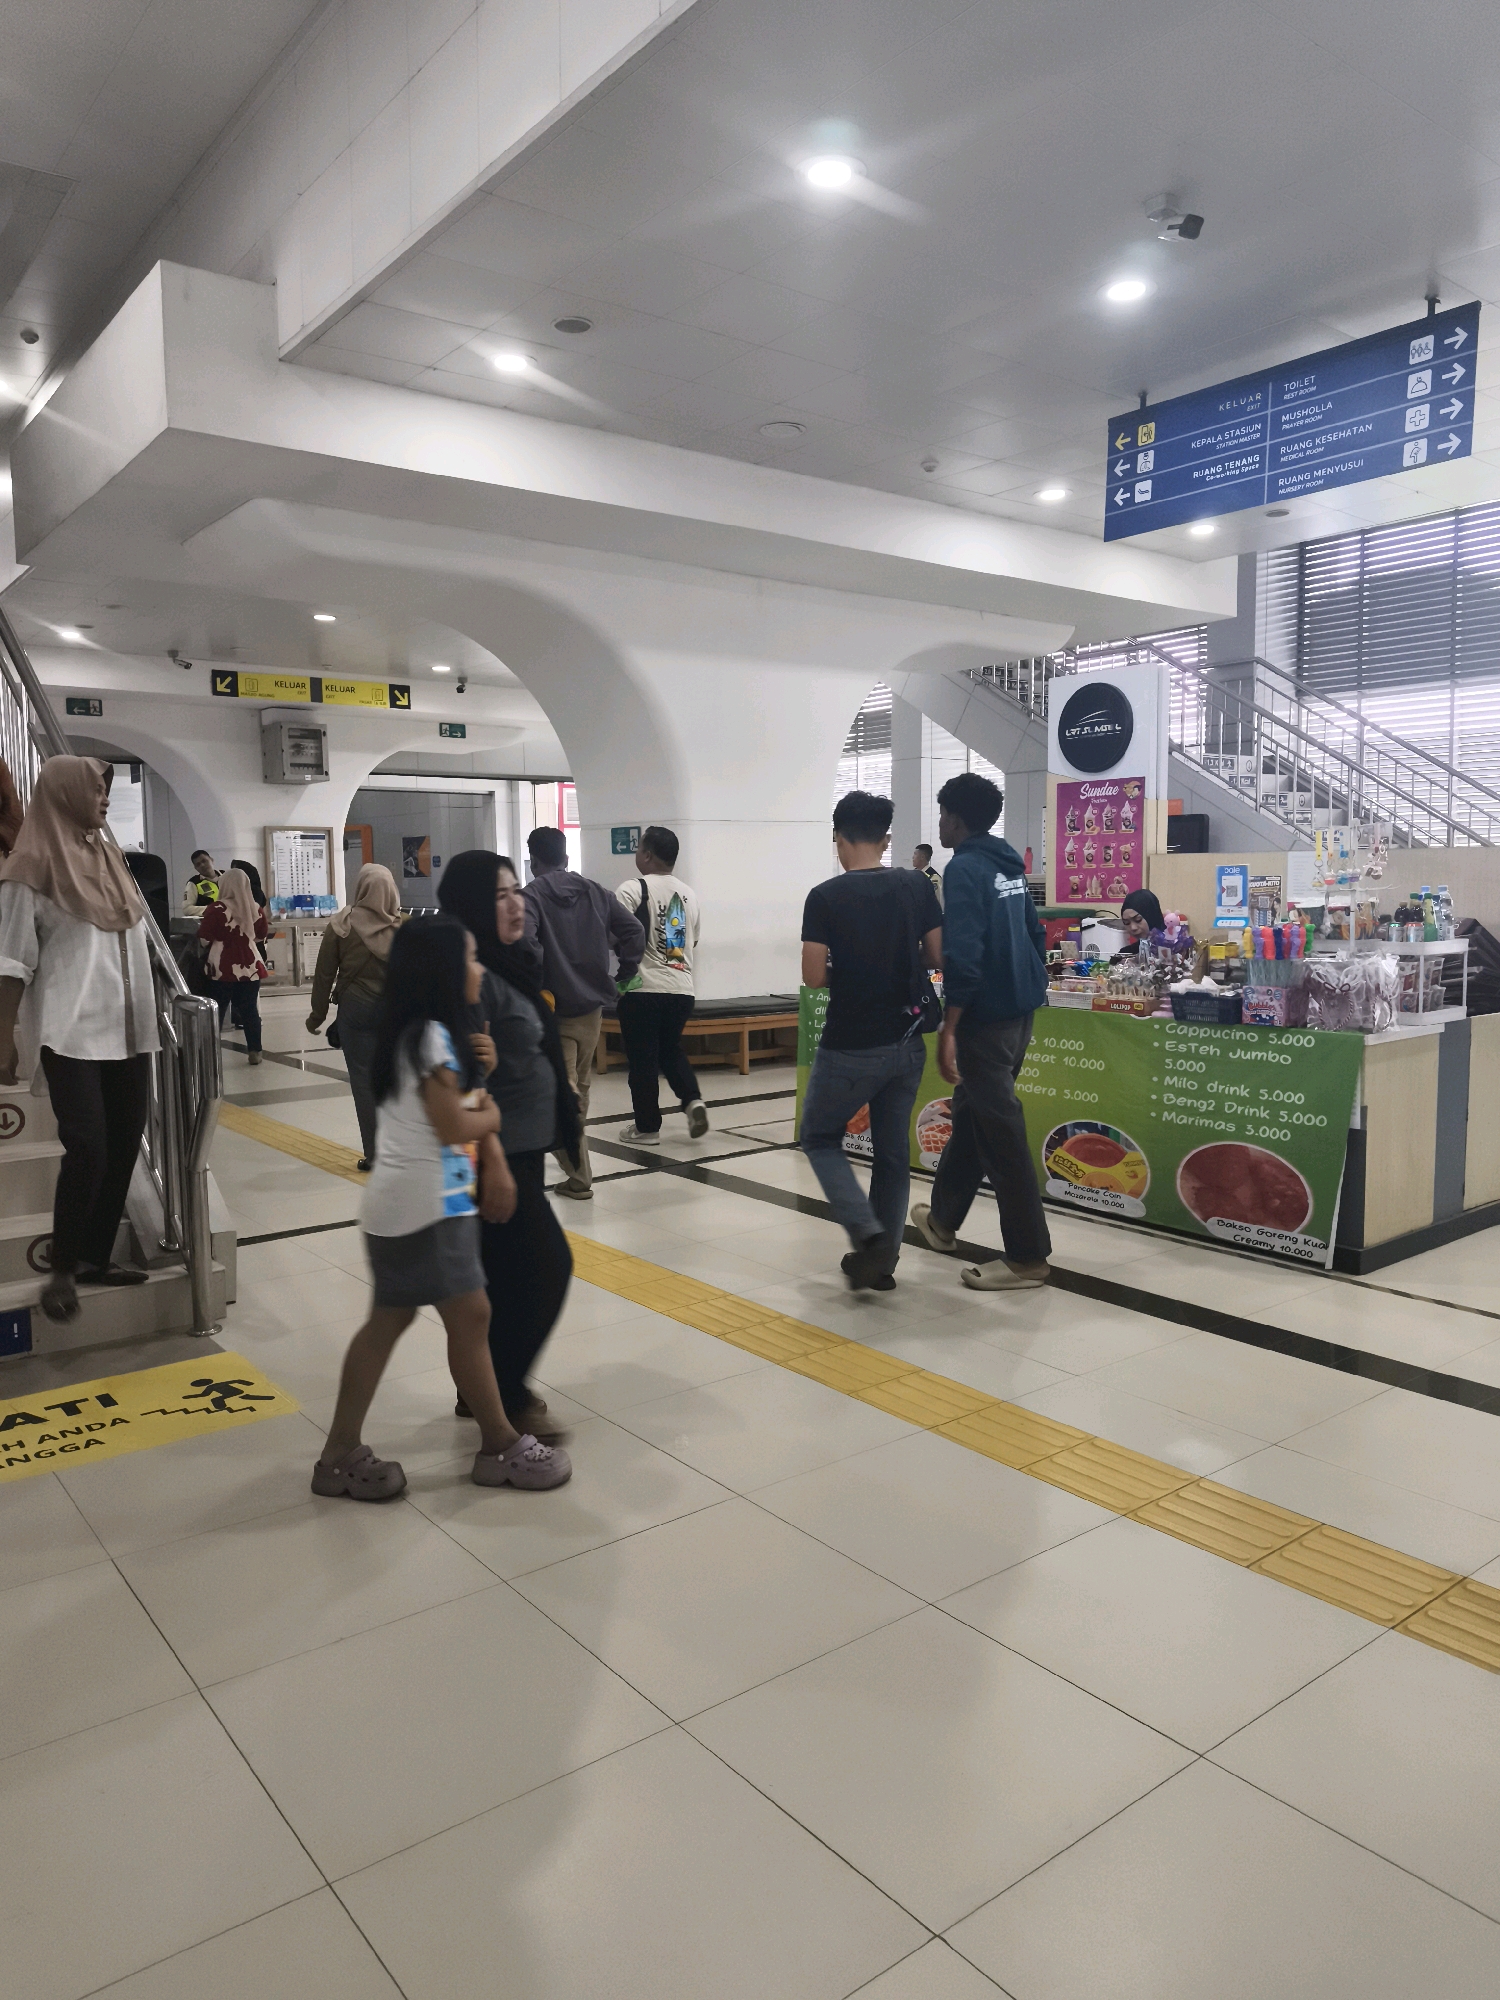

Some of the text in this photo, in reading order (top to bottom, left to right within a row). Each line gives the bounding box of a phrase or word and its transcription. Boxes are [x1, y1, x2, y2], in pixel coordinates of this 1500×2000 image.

[1283, 375, 1316, 392] TOILET
[1283, 385, 1317, 400] REST ROOM
[1219, 392, 1262, 411] KELUAR
[1246, 402, 1261, 412] EXIT
[1281, 401, 1333, 423] MUSHOLLA
[1281, 414, 1323, 431] PRAYER ROOM
[1191, 423, 1262, 449] KEPALA STASIUN
[1216, 432, 1261, 450] STATION MASTER
[1280, 423, 1373, 455] RUANG KESEHATAN
[1280, 446, 1325, 462] MEDICAL ROOM
[1193, 454, 1260, 479] RUANG TENANG
[1205, 463, 1260, 482] Co-working Space
[1278, 459, 1364, 487] RUANG MENYUSUI
[1278, 479, 1324, 495] NURSERY ROOM
[274, 680, 307, 690] KELUAR
[325, 684, 356, 694] KELUAR
[1079, 781, 1120, 800] Sundae
[816, 992, 831, 1002] An
[1110, 1003, 1132, 1011] LOLIPOP
[1043, 1037, 1084, 1051] 10.000
[1165, 1022, 1316, 1048] Cappucino 5.000
[1023, 1052, 1105, 1071] weat 10.000
[1164, 1058, 1206, 1073] 5.000
[1228, 1048, 1292, 1065] Jumbo
[1014, 1082, 1099, 1103] ndera 5.000
[1163, 1075, 1305, 1105] Milo drink 5.000
[1162, 1093, 1328, 1127] Beng2 Drink 5.000
[1162, 1111, 1291, 1142] Marimas 3.000
[1068, 1182, 1122, 1200] Pancake Coin
[1101, 1199, 1125, 1209] 10.000
[1216, 1219, 1252, 1233] Bakso
[1256, 1228, 1299, 1245] Goreng
[1233, 1234, 1313, 1259] Creamy 10.000
[0, 1393, 119, 1432] ATI
[37, 1417, 131, 1445] ANDA
